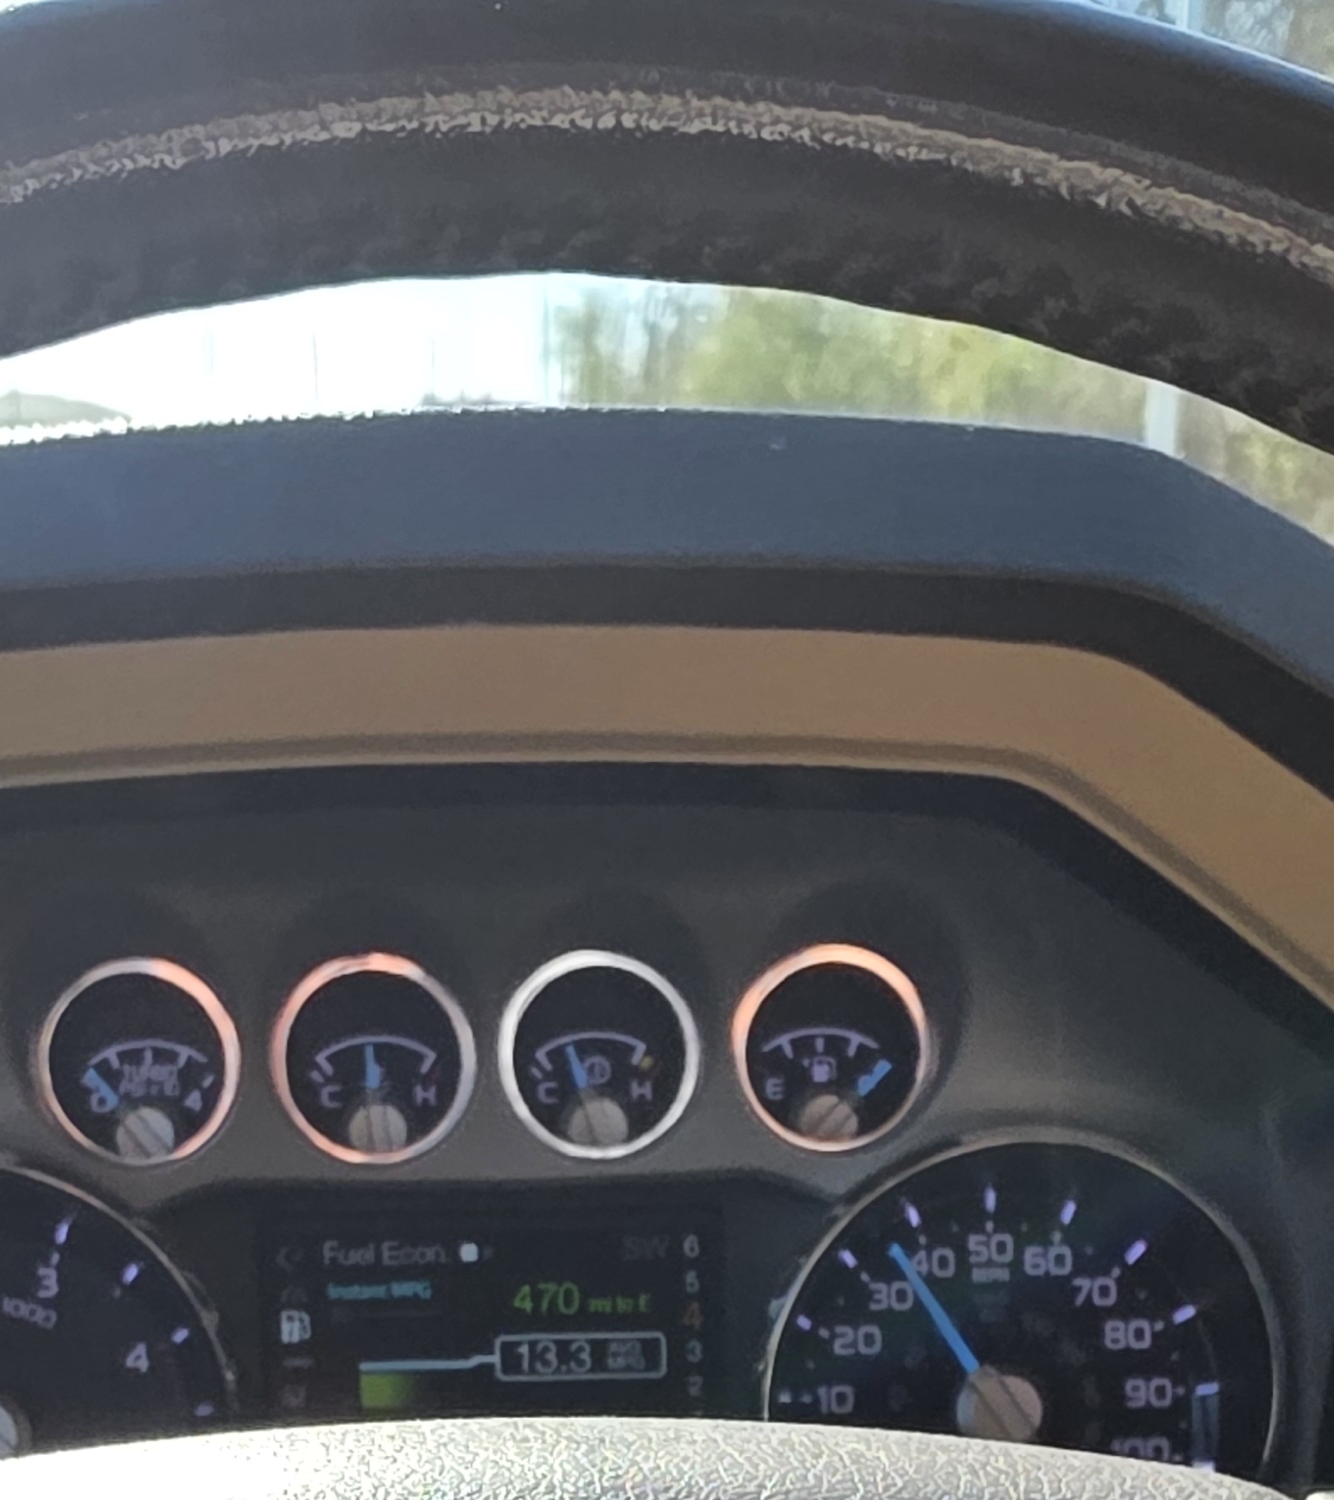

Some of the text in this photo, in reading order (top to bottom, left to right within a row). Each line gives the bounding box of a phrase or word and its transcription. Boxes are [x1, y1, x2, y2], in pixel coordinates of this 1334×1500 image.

[765, 1078, 784, 1100] E
[322, 1240, 375, 1266] Fuel
[911, 1247, 956, 1278] 40
[968, 1233, 1014, 1264] 50
[1023, 1244, 1073, 1276] 60
[37, 1266, 59, 1298] 3
[868, 1281, 914, 1311] 30
[1072, 1276, 1117, 1307] 70
[2, 1297, 58, 1330] 1000
[513, 1281, 580, 1315] 470
[832, 1325, 882, 1356] 20
[1104, 1320, 1152, 1350] 80
[125, 1342, 150, 1374] 4
[517, 1340, 592, 1374] 13.3
[817, 1385, 855, 1415] 10
[1125, 1378, 1173, 1408] 90
